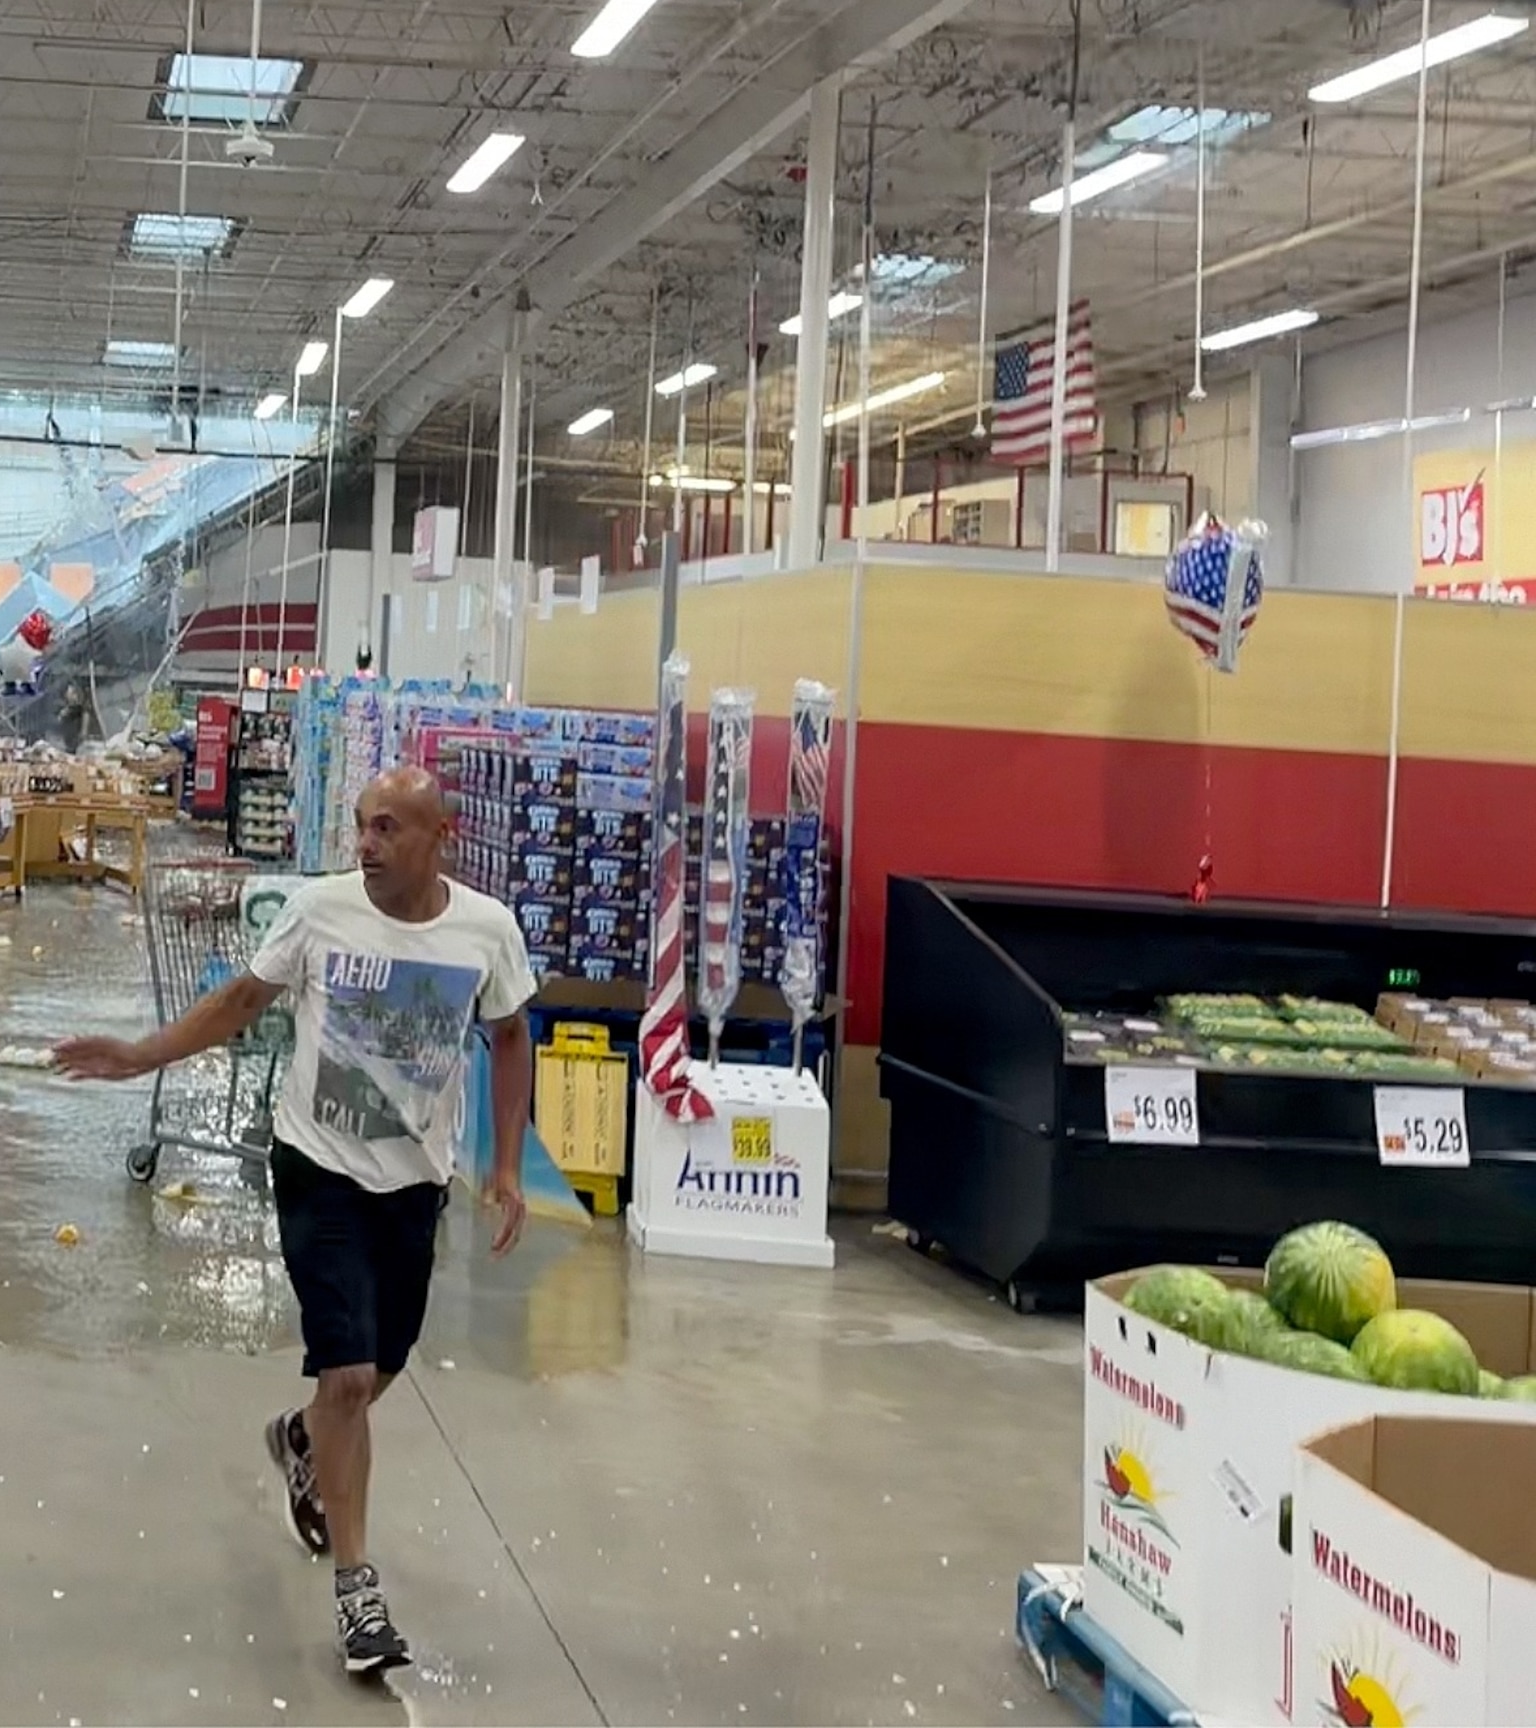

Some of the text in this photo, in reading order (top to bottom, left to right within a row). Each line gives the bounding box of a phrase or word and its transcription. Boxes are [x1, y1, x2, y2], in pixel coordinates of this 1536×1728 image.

[1422, 467, 1486, 566] BJ's
[331, 953, 393, 991] AERO
[1134, 1094, 1193, 1133] $6.99
[1403, 1117, 1463, 1153] $5.29
[1312, 1527, 1458, 1662] Watermelons
